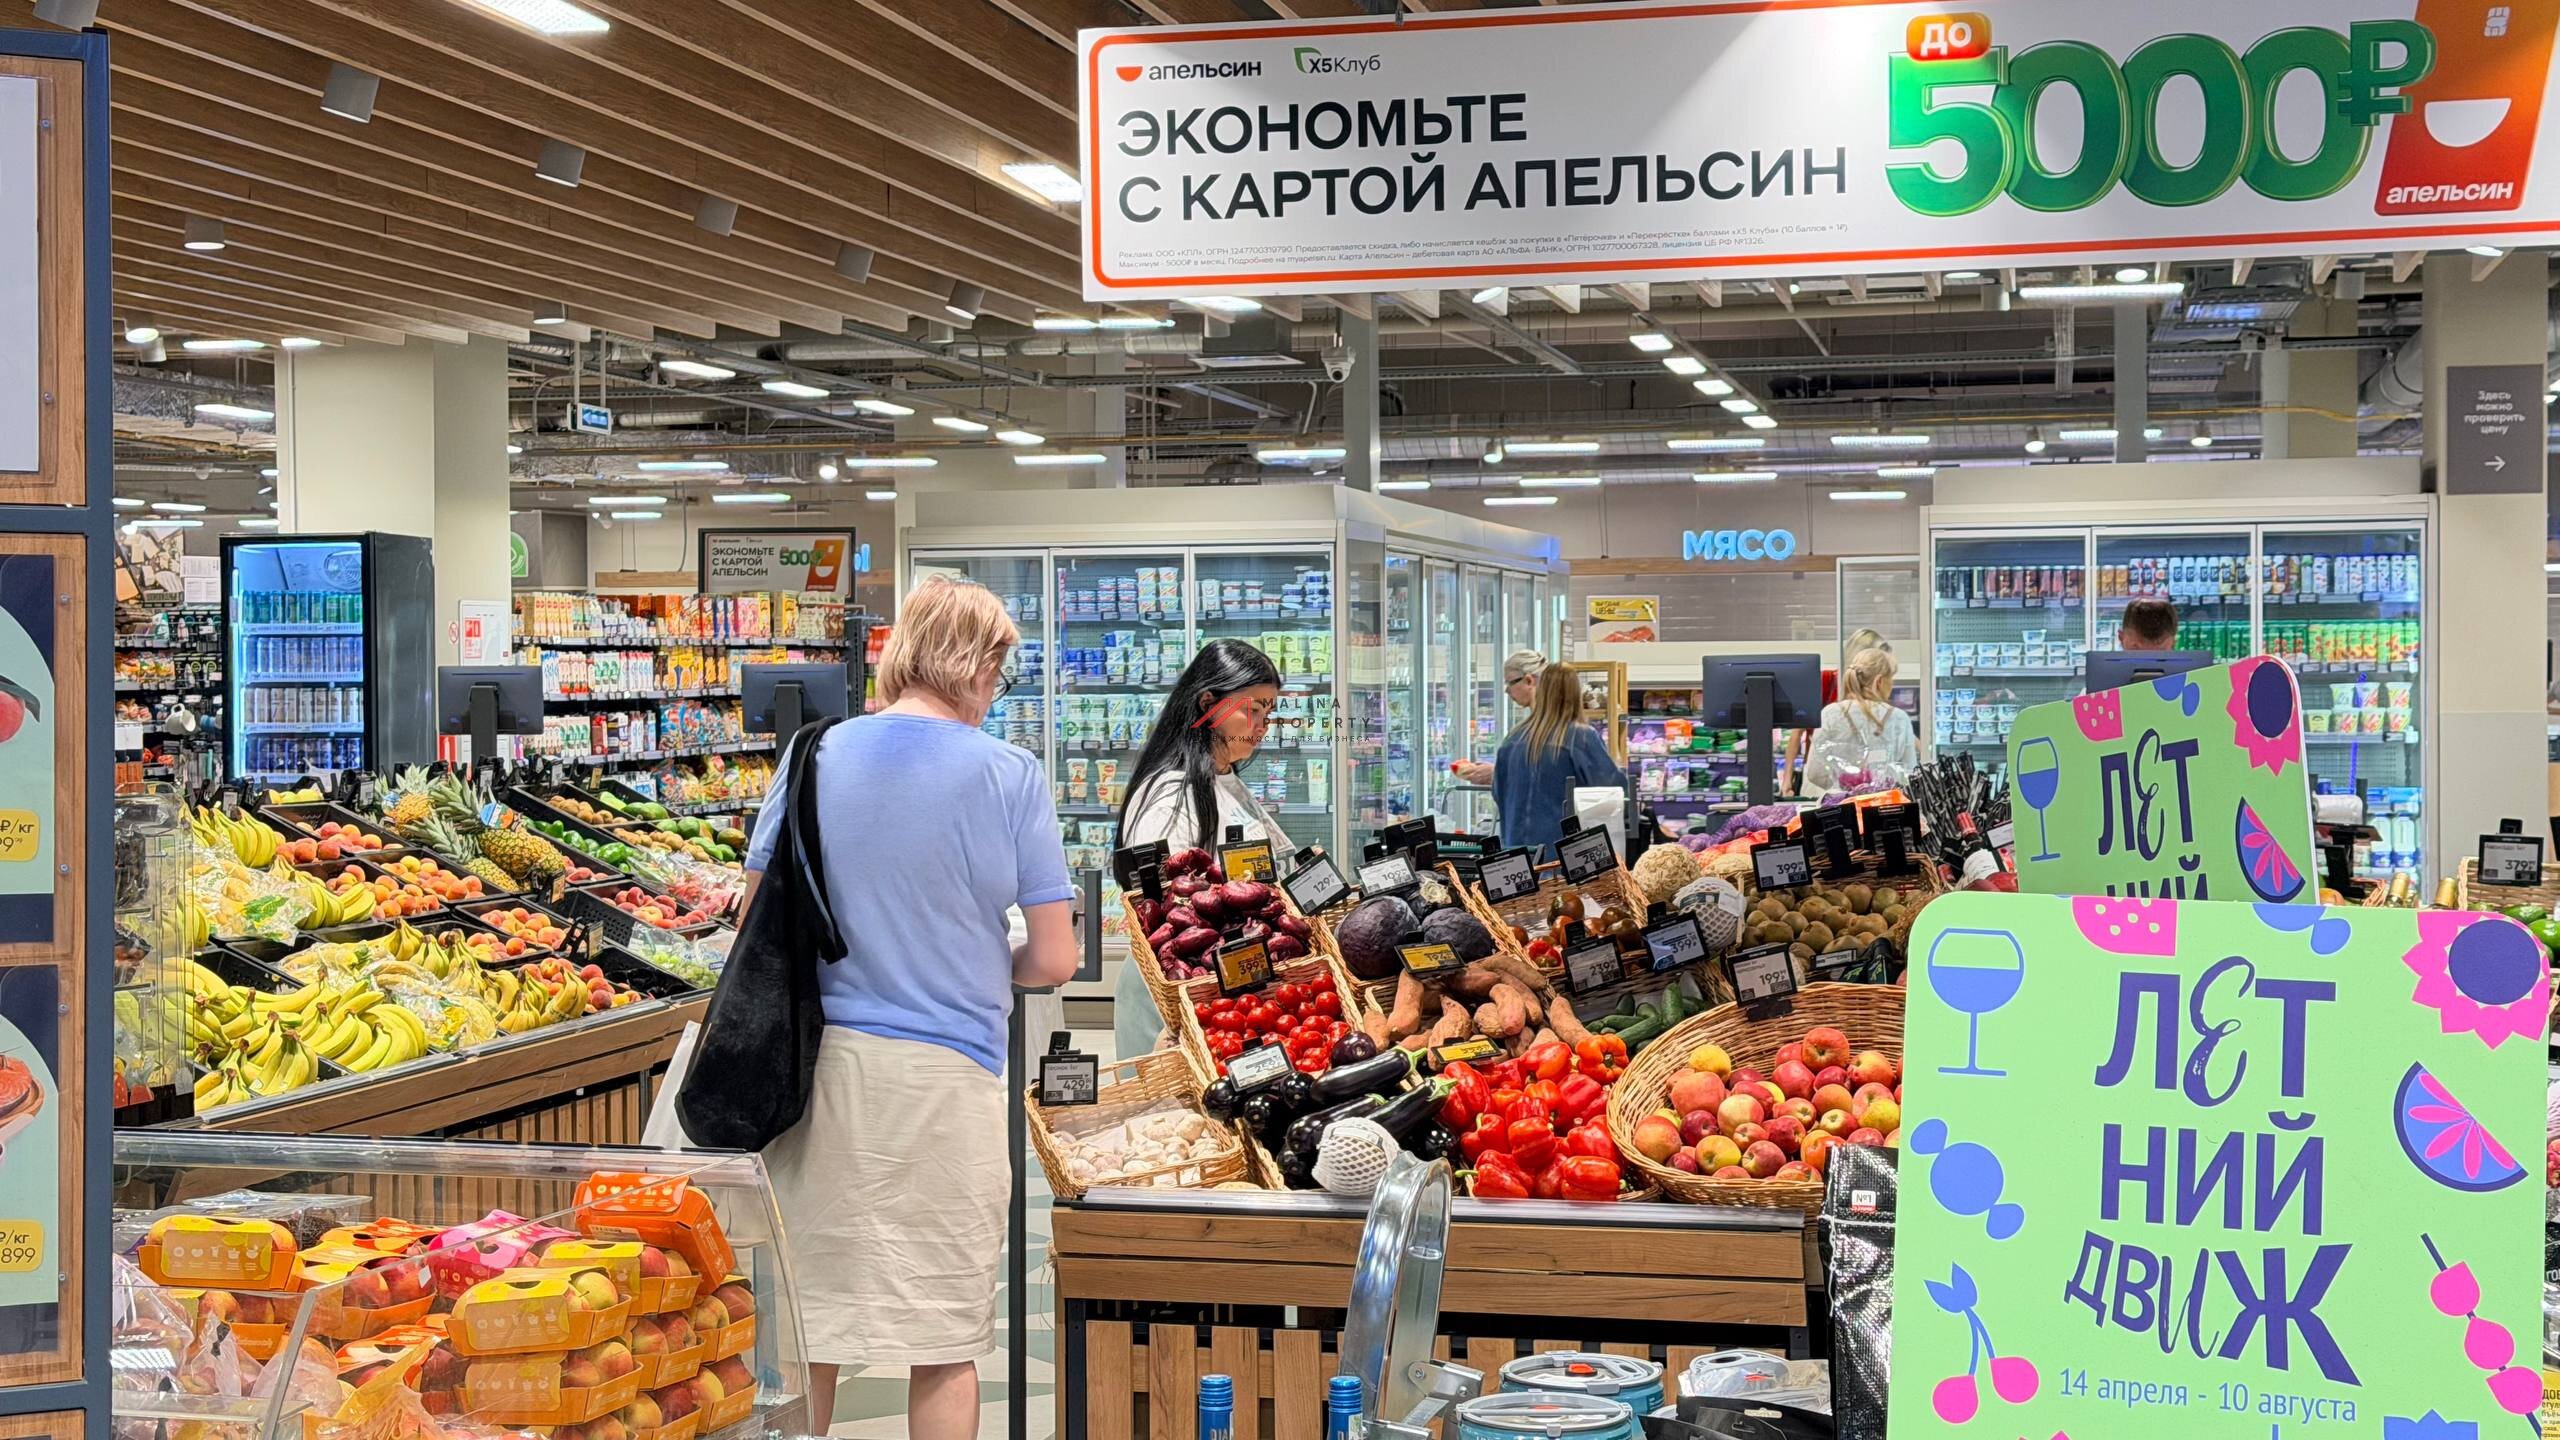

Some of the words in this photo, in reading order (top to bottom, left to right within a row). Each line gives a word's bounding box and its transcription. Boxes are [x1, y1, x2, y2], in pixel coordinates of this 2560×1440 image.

[1149, 61, 1261, 80] апельсин
[1117, 93, 1526, 157] ЭКОНОМЬТЕ
[1886, 20, 2437, 217] 5000₽
[1119, 176, 1162, 223] С
[1183, 152, 1445, 221] КАРТОЙ
[1464, 146, 1846, 211] АПЕЛЬСИН
[2386, 181, 2514, 204] апельсин
[2478, 390, 2512, 402] Здесь
[2476, 402, 2513, 411] можно
[2464, 413, 2526, 425] проверить
[2480, 425, 2509, 435] цену
[1683, 528, 1796, 560] МЯСО
[712, 547, 775, 556] ЭКОНОМЬТЕ
[712, 558, 719, 566] С
[721, 556, 763, 566] КАРТОЙ
[711, 567, 769, 576] АПЕЛЬСИН
[1776, 862, 1799, 875] 399
[2504, 859, 2529, 872] 379
[1759, 971, 1781, 986] 199
[1062, 1079, 1086, 1091] 429
[2100, 1111, 2324, 1236] НИЙ
[2064, 1230, 2363, 1387] ДВИЖ
[2061, 1367, 2088, 1397] 14
[2097, 1378, 2188, 1408] апреля
[2218, 1382, 2249, 1411] 10
[2258, 1393, 2356, 1424] августа
